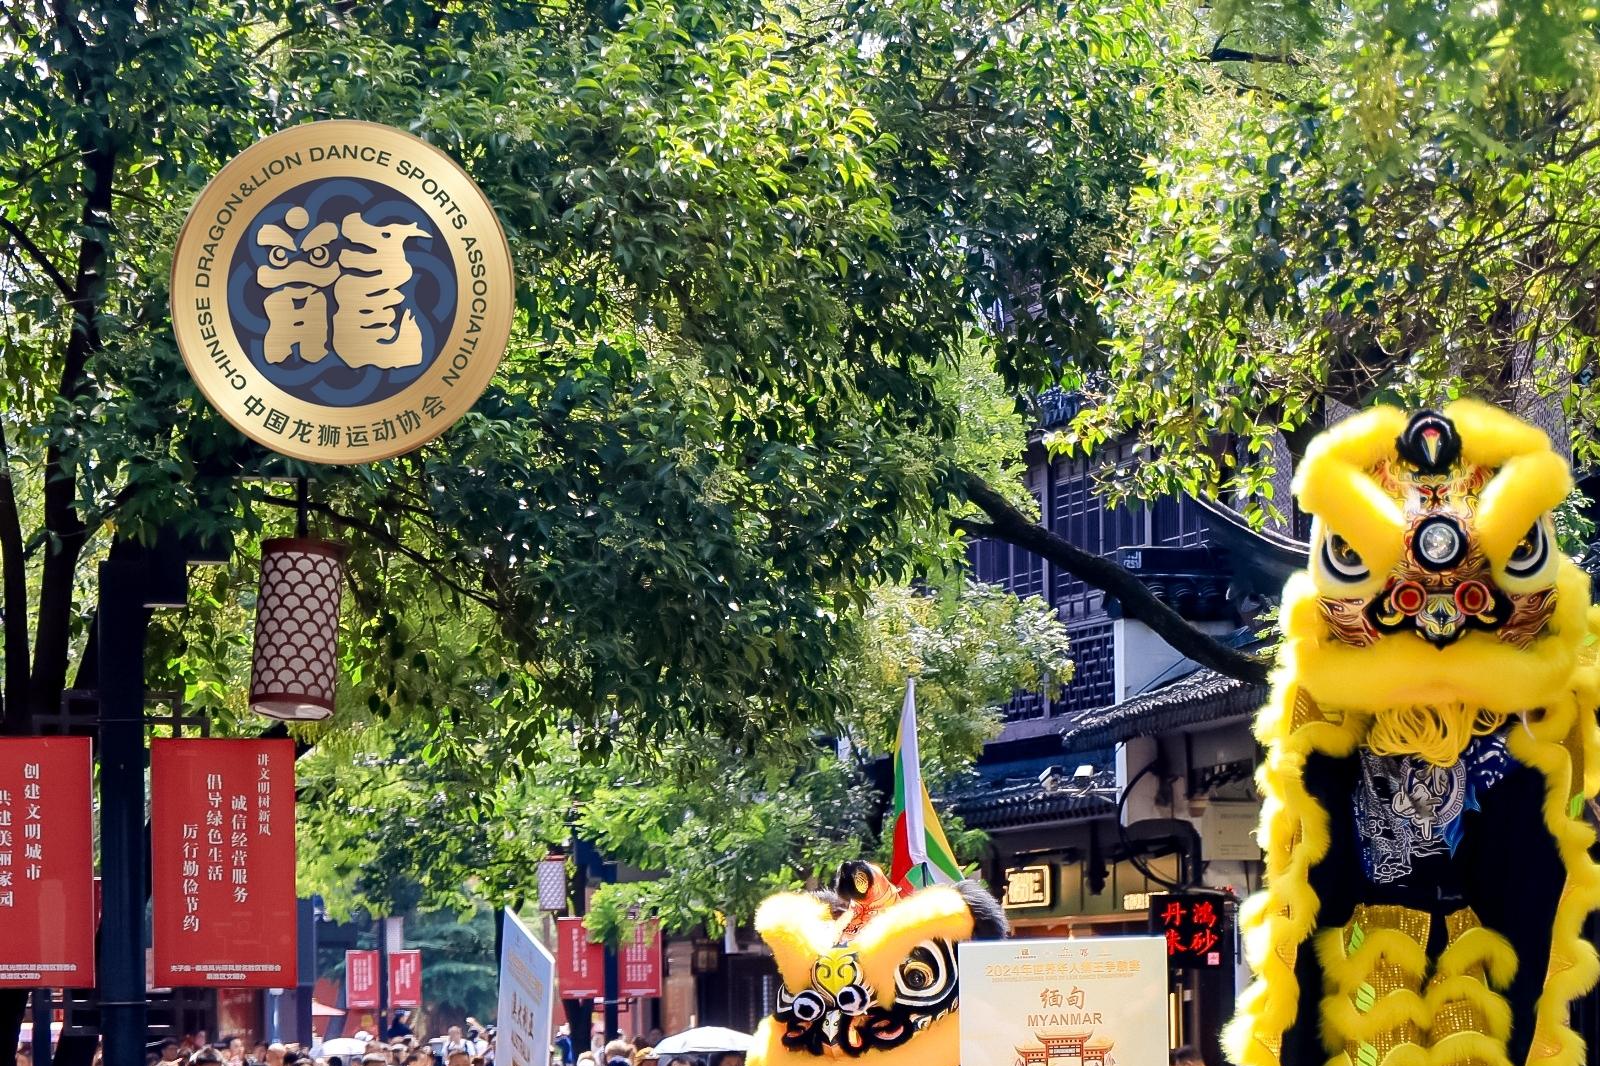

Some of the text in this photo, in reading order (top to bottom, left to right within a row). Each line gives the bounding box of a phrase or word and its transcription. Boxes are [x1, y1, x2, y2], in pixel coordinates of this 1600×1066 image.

[24, 762, 42, 881] 创建文明城市
[206, 773, 223, 882] 倡导绿色生活
[257, 753, 271, 836] 讲文明树新风
[182, 823, 200, 932] 厉行勤俭节约
[231, 795, 249, 904] 诚信经营服务
[1027, 1013, 1103, 1027] MYANMAR
[1040, 986, 1086, 1009] 缅甸
